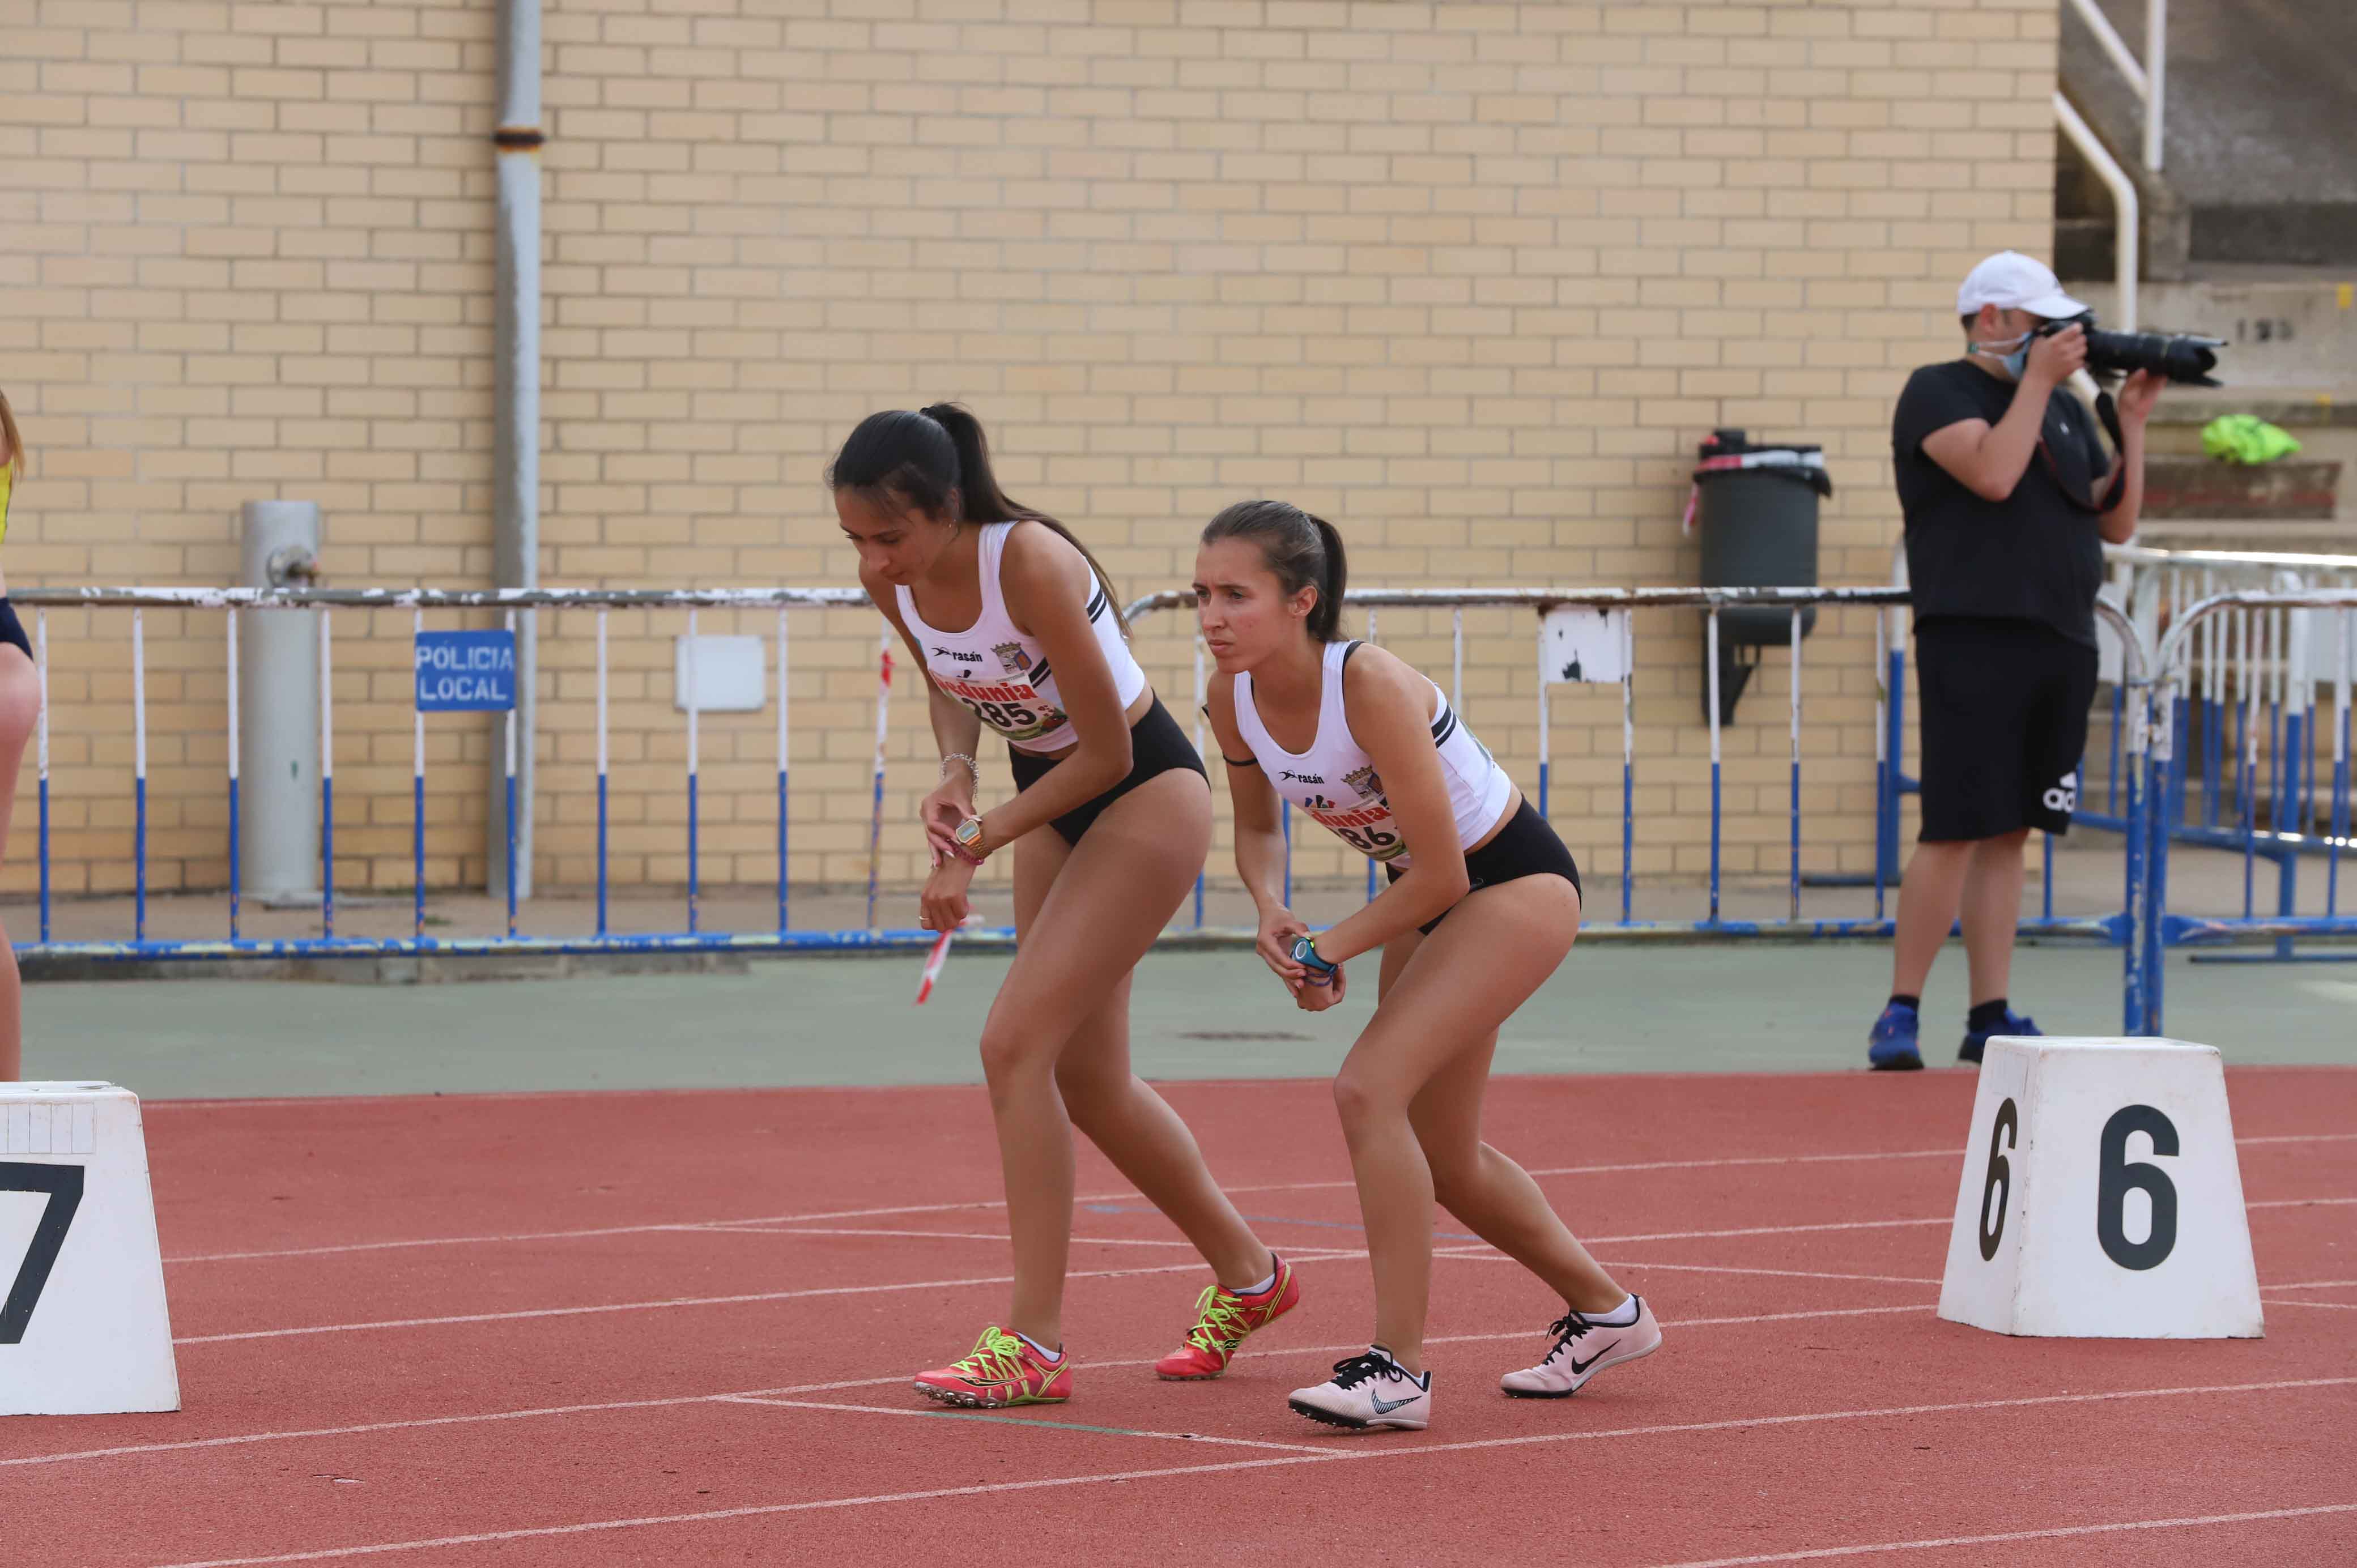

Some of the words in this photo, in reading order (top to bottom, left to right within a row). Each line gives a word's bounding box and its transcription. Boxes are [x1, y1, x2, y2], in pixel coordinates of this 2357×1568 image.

[416, 646, 513, 670] POLICIA
[952, 651, 983, 663] rasán
[420, 676, 508, 701] LOCAL
[1297, 773, 1325, 785] rasán
[1327, 825, 1396, 850] 86
[1979, 1097, 2018, 1262] 6
[2097, 1104, 2180, 1271] 6
[0, 1162, 84, 1344] 7
